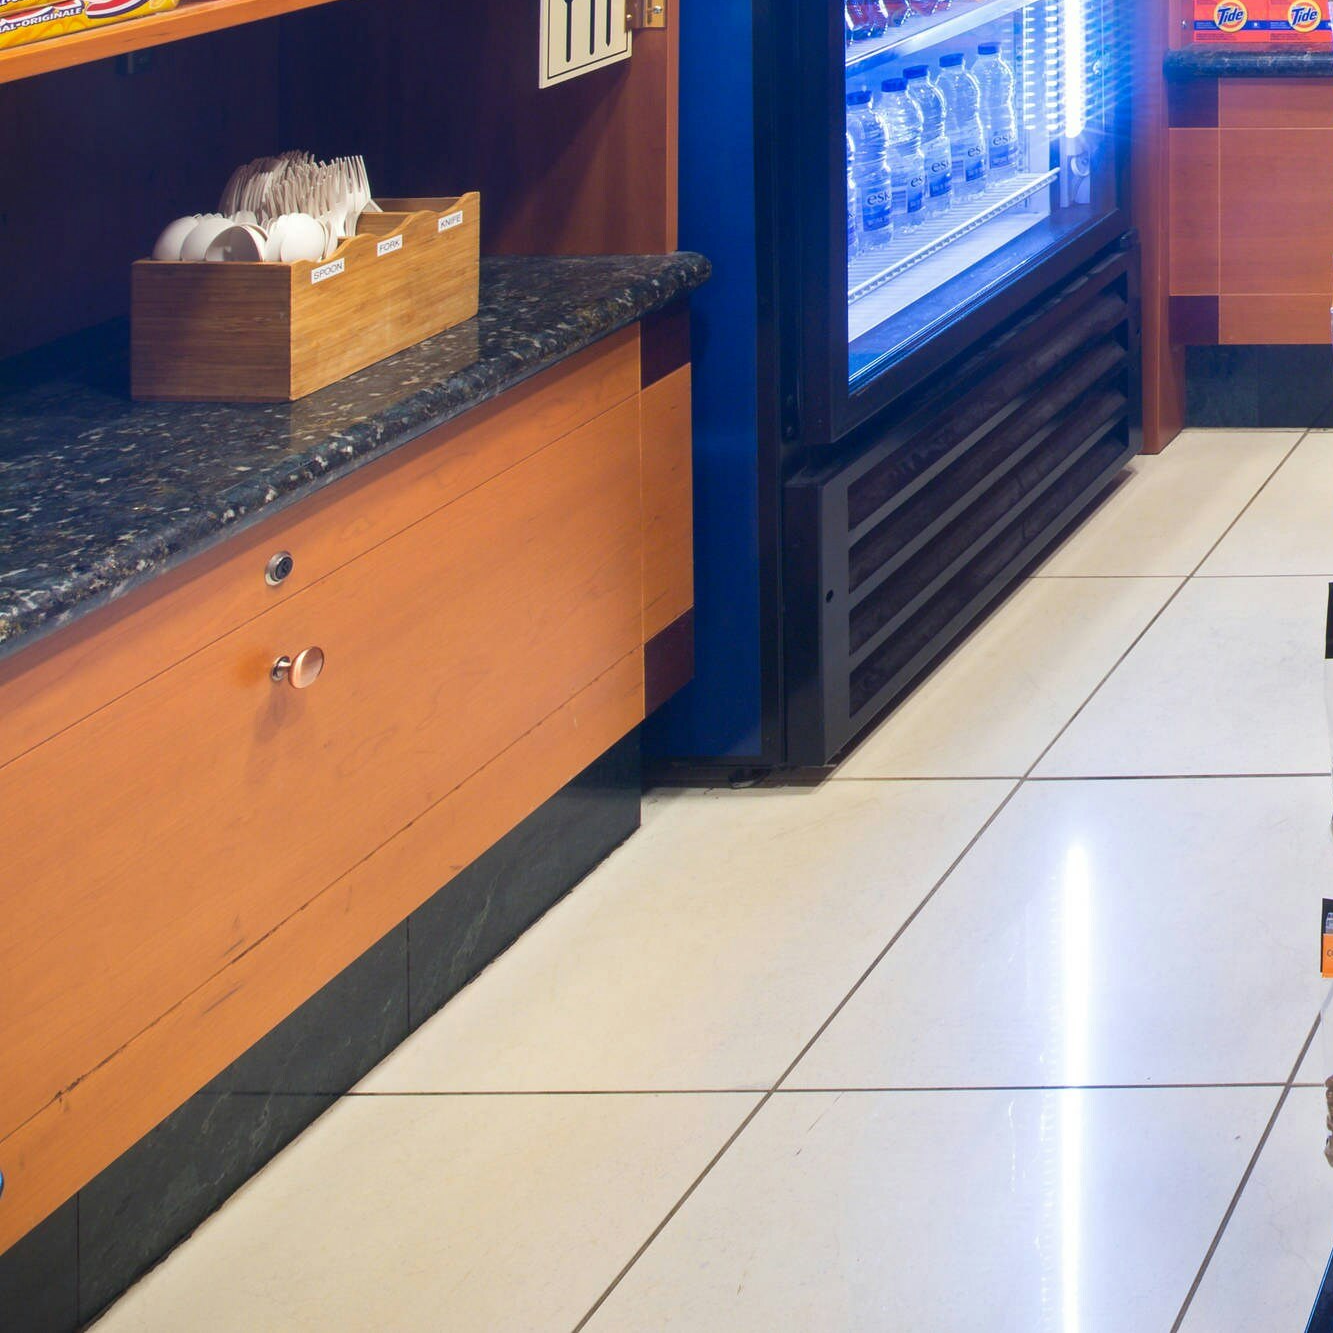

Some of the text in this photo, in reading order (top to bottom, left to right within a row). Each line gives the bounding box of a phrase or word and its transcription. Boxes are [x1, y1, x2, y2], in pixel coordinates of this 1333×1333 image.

[1218, 7, 1243, 25] Tide
[1292, 7, 1317, 25] Tide
[441, 216, 461, 228] KNIFE
[379, 241, 400, 252] FORK
[314, 263, 342, 280] SPOON
